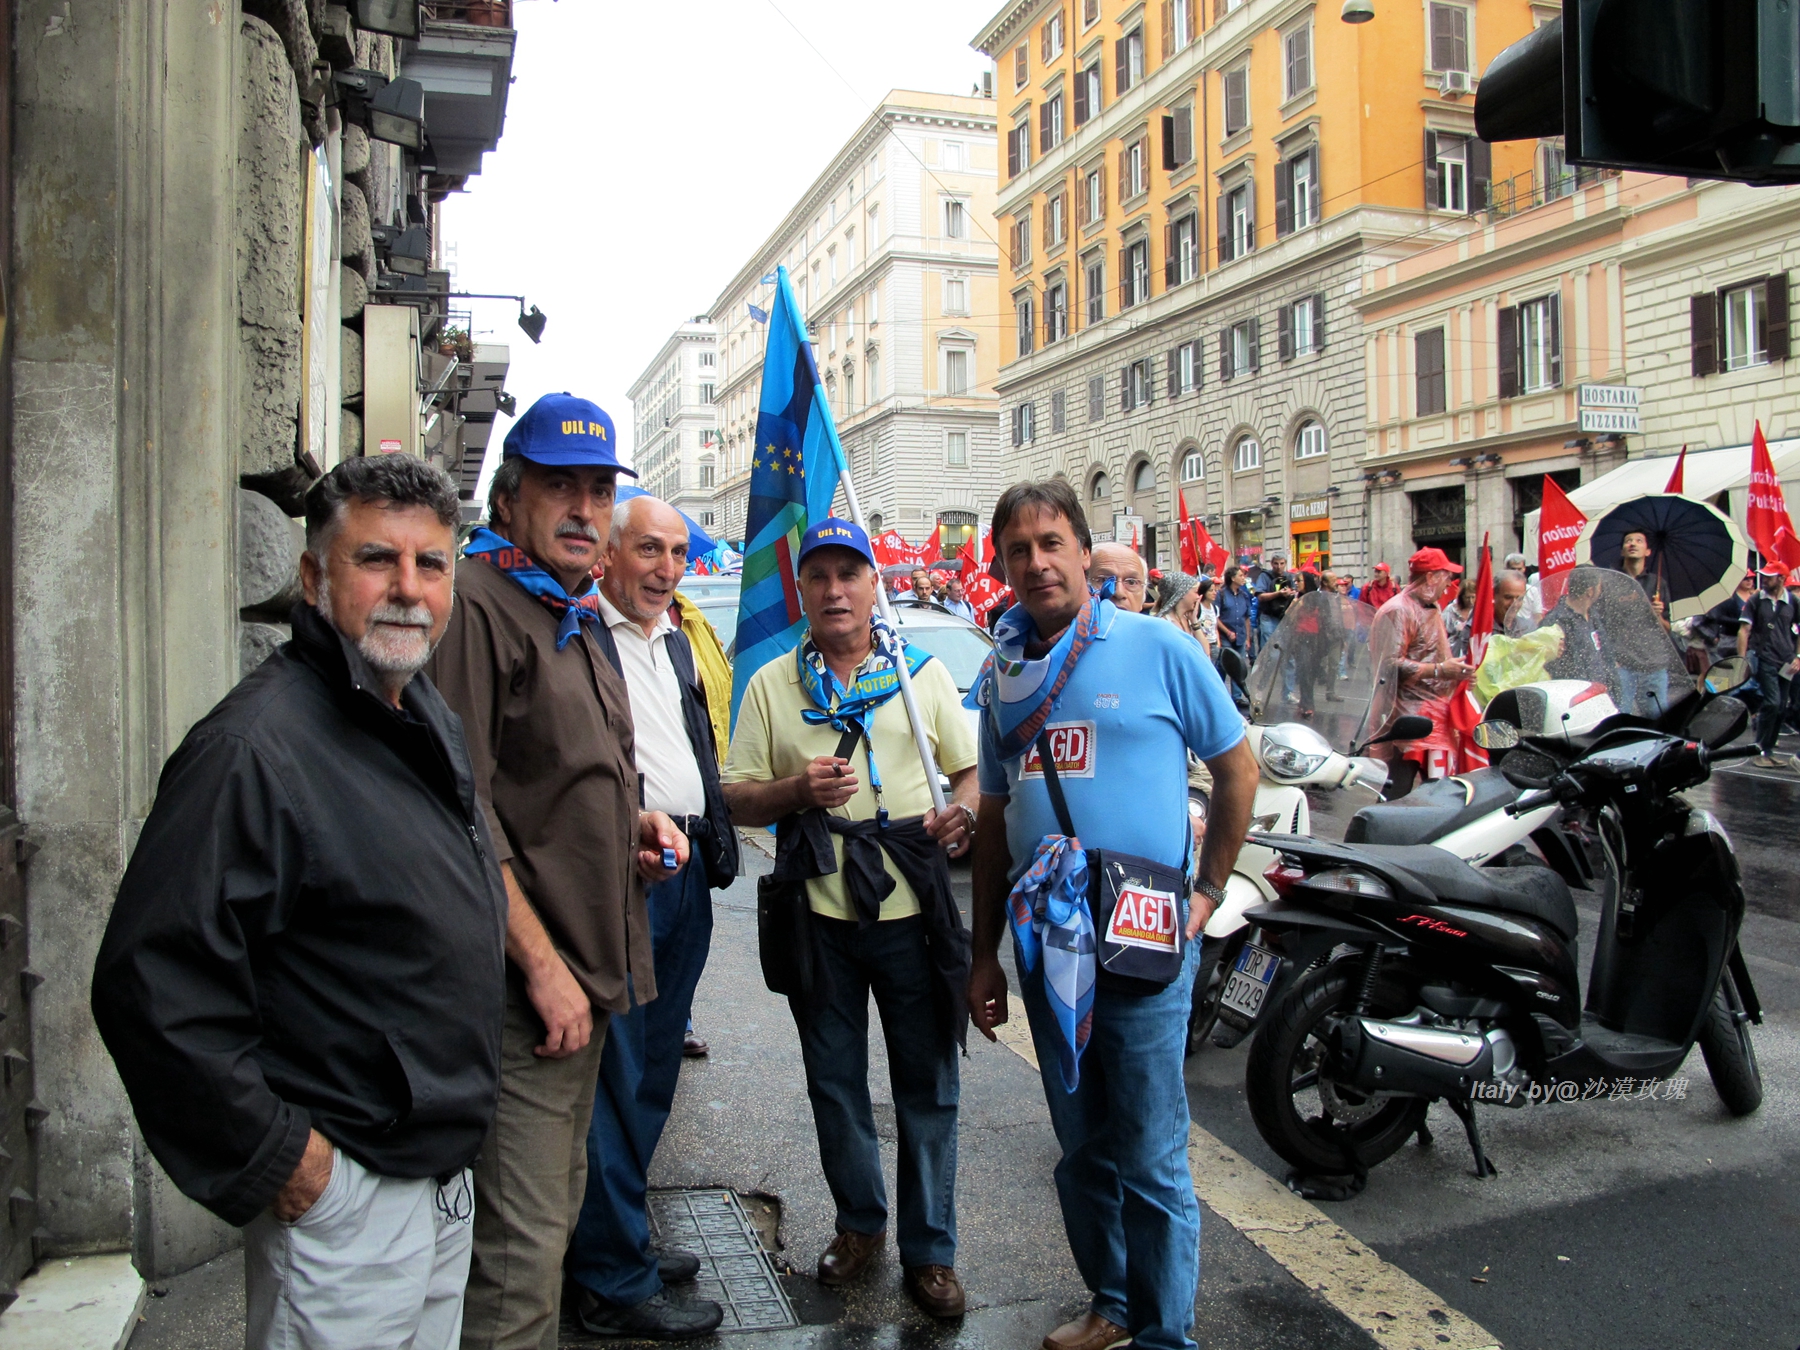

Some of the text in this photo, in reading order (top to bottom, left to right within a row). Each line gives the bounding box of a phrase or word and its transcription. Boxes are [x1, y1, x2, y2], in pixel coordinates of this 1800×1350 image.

[1584, 389, 1637, 404] HOSTARIA
[562, 420, 607, 441] UIL FPL
[1584, 414, 1637, 429] PIZZERIA
[1291, 503, 1305, 518] PIZZA
[818, 527, 853, 539] UIL FPL
[1116, 892, 1175, 935] AGD
[1244, 950, 1263, 976] DR
[1225, 977, 1263, 1011] 91249
